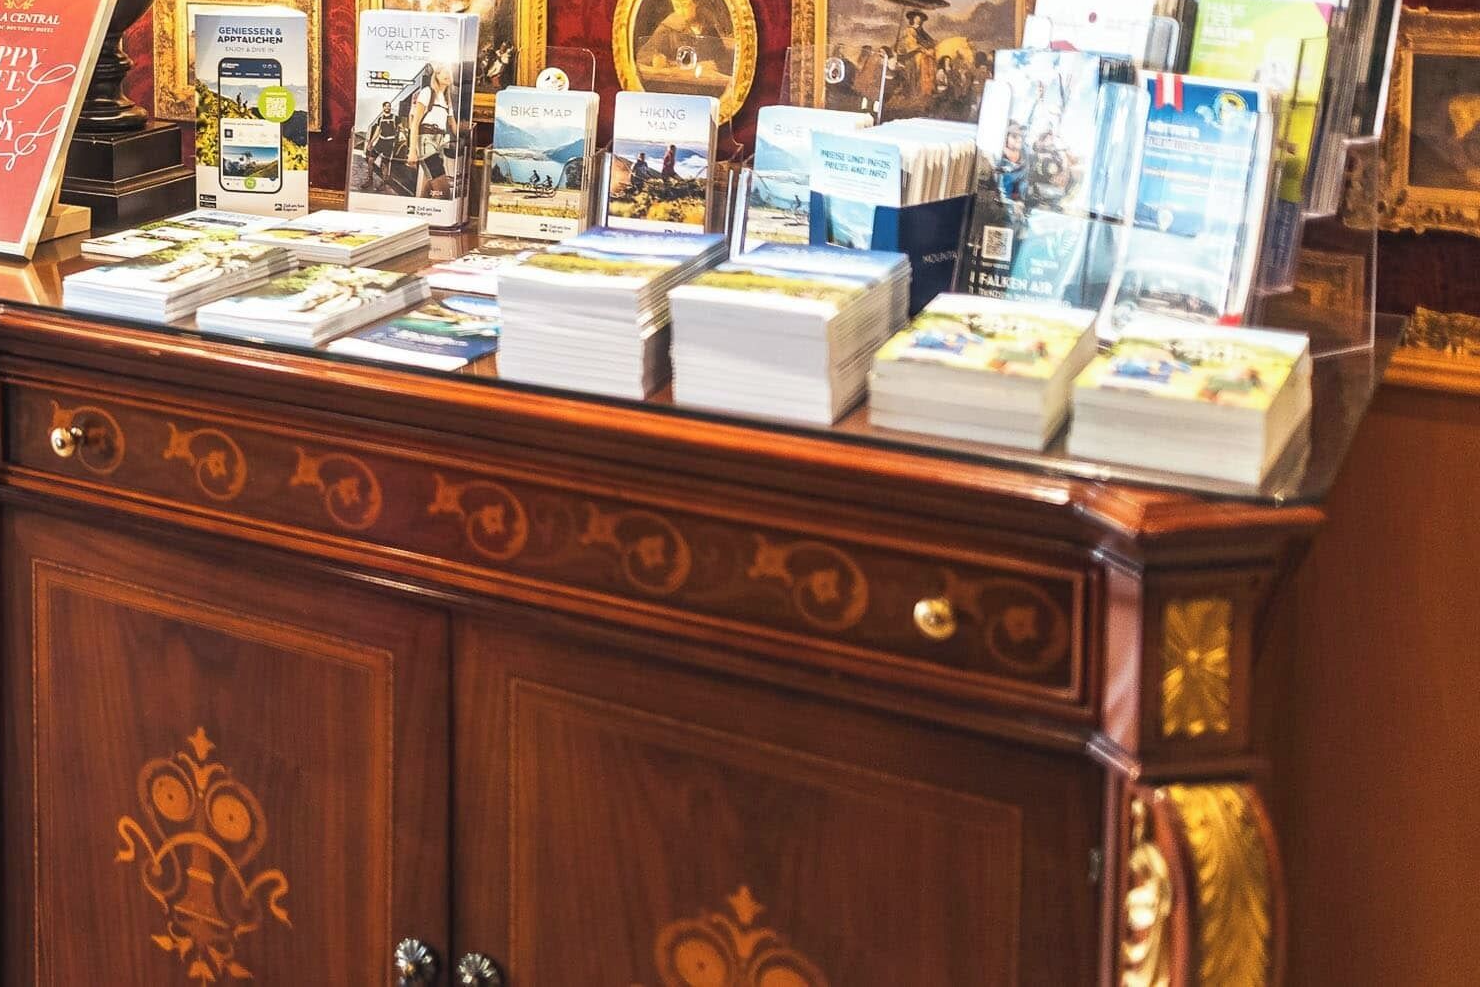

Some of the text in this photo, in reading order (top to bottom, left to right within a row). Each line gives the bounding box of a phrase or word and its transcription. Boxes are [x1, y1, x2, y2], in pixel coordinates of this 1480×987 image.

[10, 12, 60, 25] CENTRAL
[218, 27, 282, 36] GENIESSEN &
[367, 24, 450, 40] MOBILITÄTS-
[217, 36, 283, 45] APPTAUCHEN
[385, 40, 431, 53] KARTE
[510, 106, 572, 119] BIKE MAP
[639, 107, 686, 120] HIKING
[647, 120, 678, 131] MAP
[978, 272, 1054, 295] FALKEN AIR
